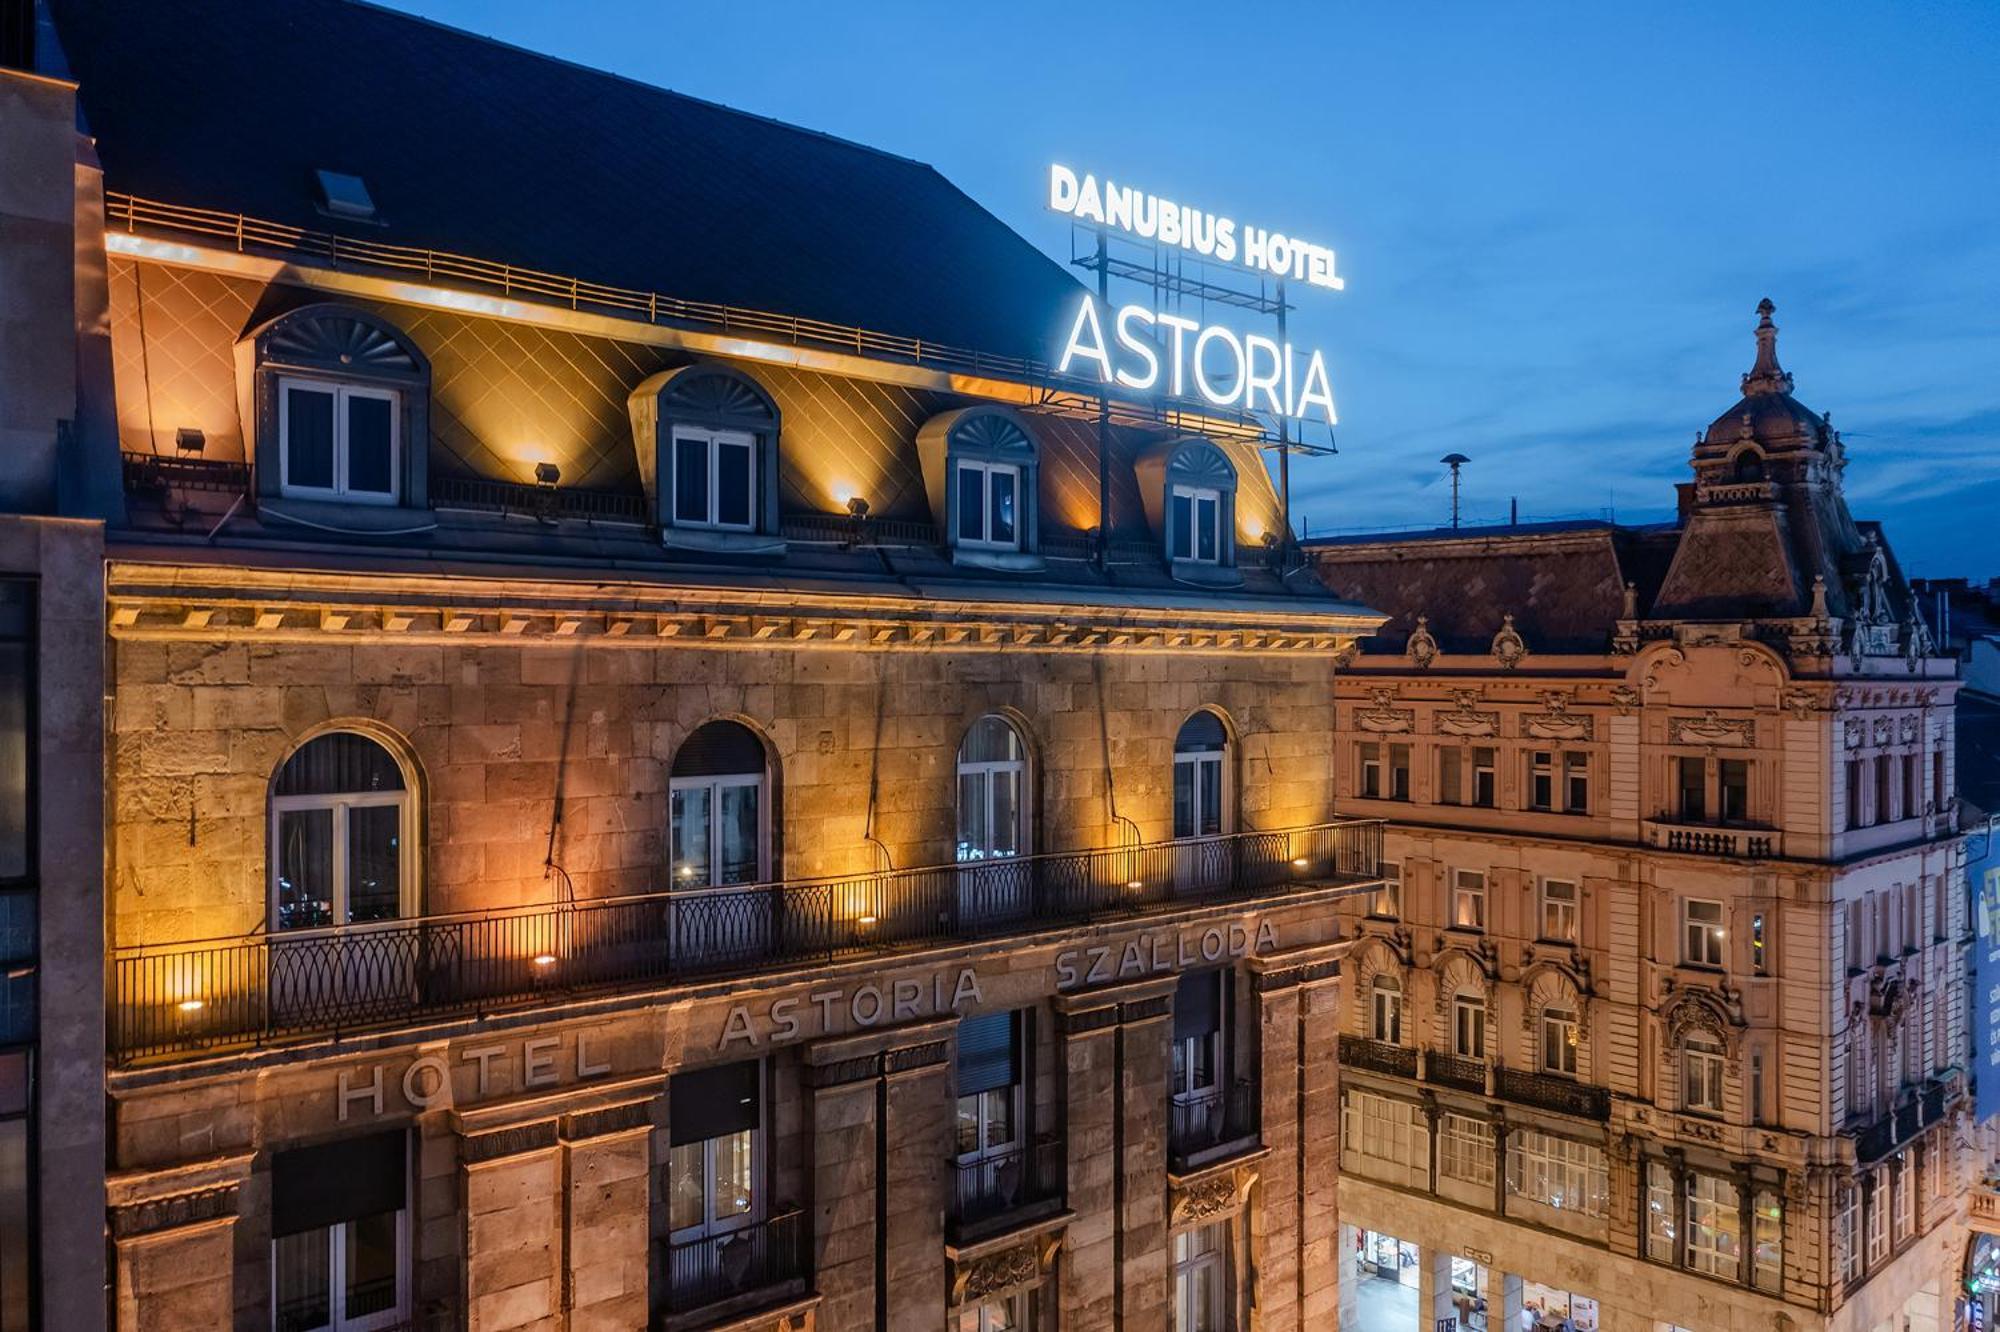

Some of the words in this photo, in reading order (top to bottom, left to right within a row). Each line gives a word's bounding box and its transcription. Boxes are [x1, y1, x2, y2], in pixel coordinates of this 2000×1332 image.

[1051, 164, 1237, 262] DANUBIUS
[1244, 225, 1345, 290] HOTEL
[1058, 295, 1338, 426] ASTORIA
[338, 1031, 612, 1120] HOTEL
[718, 968, 984, 1050] ASTORIA
